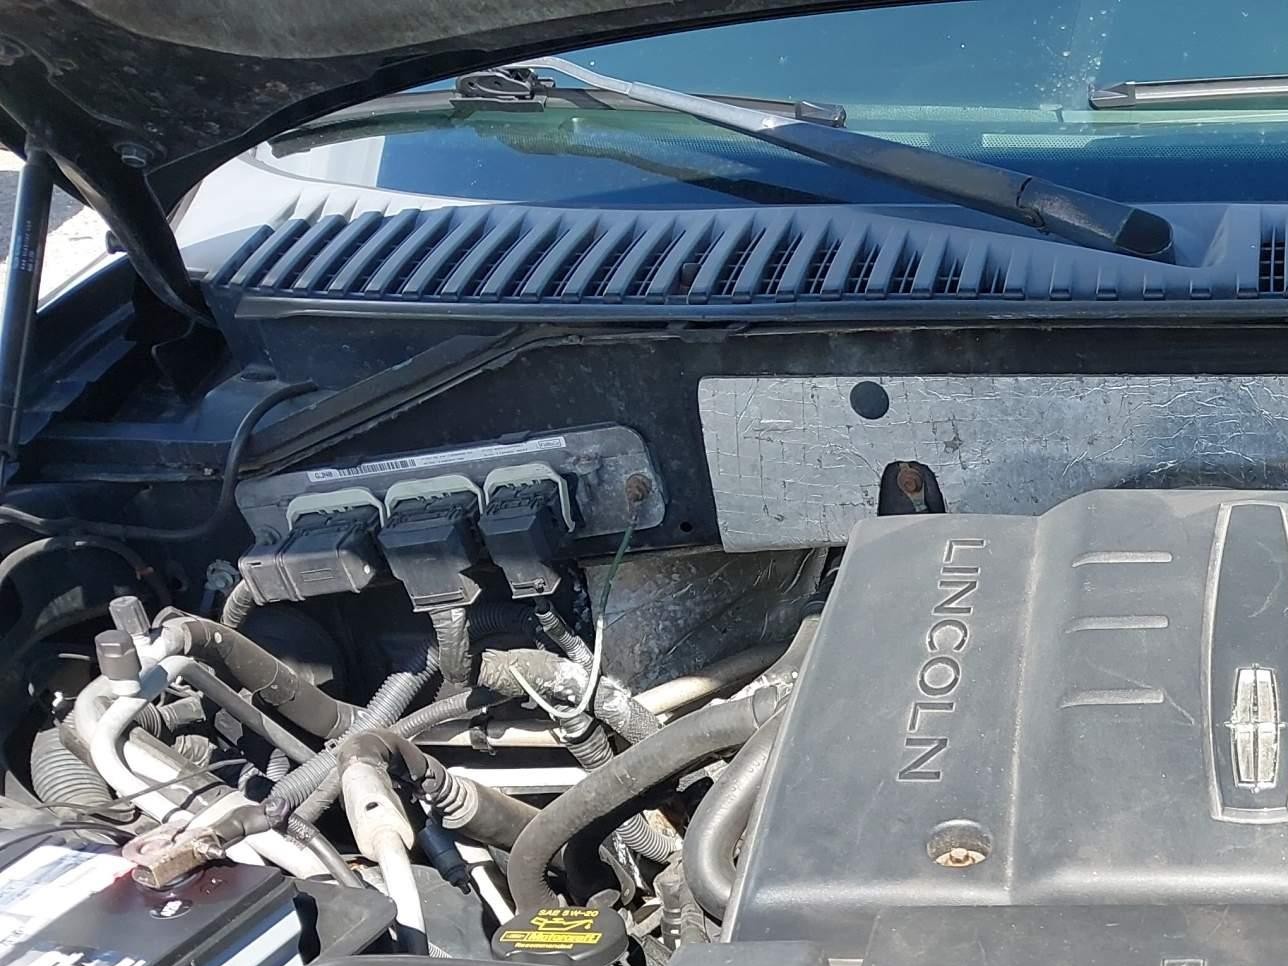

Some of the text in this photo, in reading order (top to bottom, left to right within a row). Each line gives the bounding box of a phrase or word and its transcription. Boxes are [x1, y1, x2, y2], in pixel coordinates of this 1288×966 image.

[897, 539, 985, 782] LINCOLN
[538, 909, 560, 917] SAE
[528, 931, 597, 943] Motorcraft
